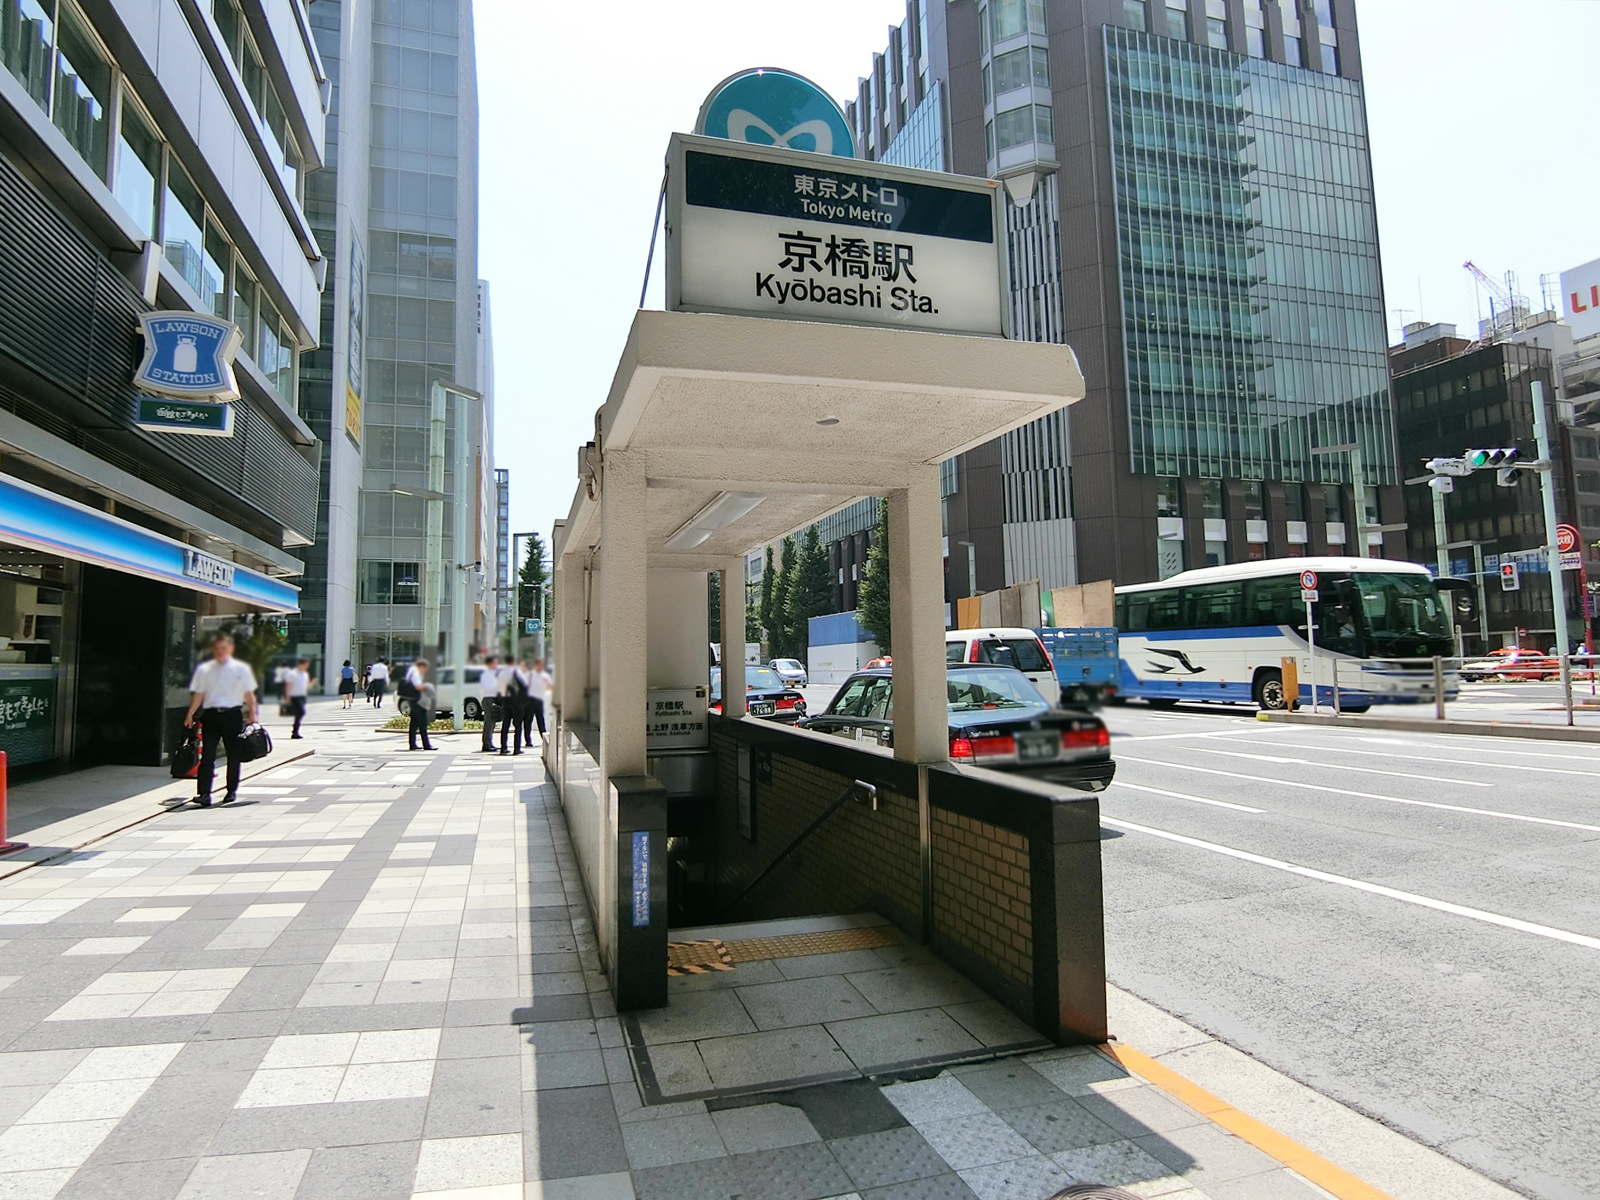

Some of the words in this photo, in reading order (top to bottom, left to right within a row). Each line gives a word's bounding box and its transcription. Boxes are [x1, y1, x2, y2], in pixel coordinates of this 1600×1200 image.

[794, 174, 898, 206] 東京メトロ
[801, 198, 845, 220] Tokyo
[849, 205, 893, 224] Metro
[778, 231, 917, 284] 京橋駅
[755, 272, 882, 309] Kyōbashi
[890, 287, 939, 314] Sta.
[153, 322, 221, 339] LAWSON
[152, 368, 216, 384] STATION
[187, 551, 236, 588] LAWSON
[655, 701, 684, 710] 京橋駅
